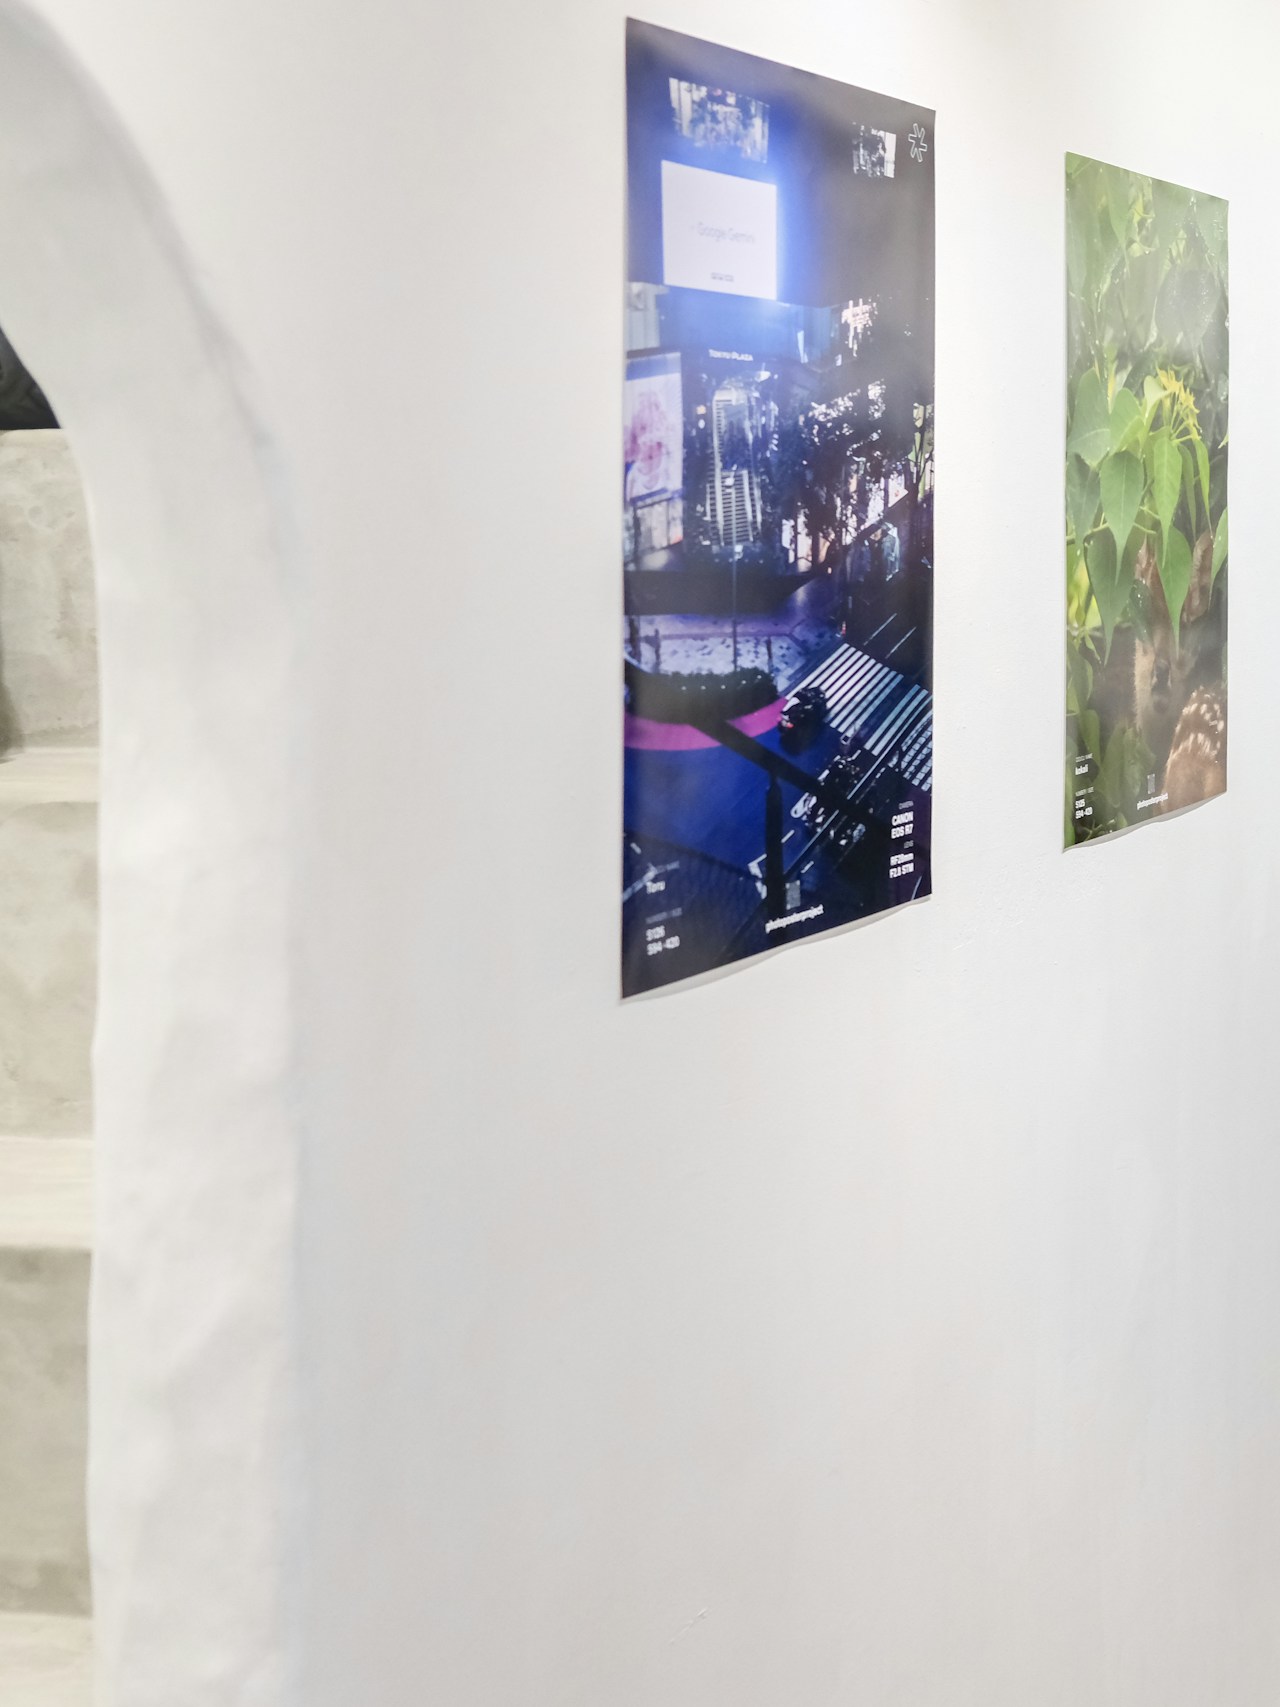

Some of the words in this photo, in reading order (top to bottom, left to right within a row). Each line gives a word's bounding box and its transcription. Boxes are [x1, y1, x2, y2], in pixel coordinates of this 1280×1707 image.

[892, 811, 914, 827] CANON
[891, 826, 904, 839] EOS
[902, 863, 914, 875] STM
